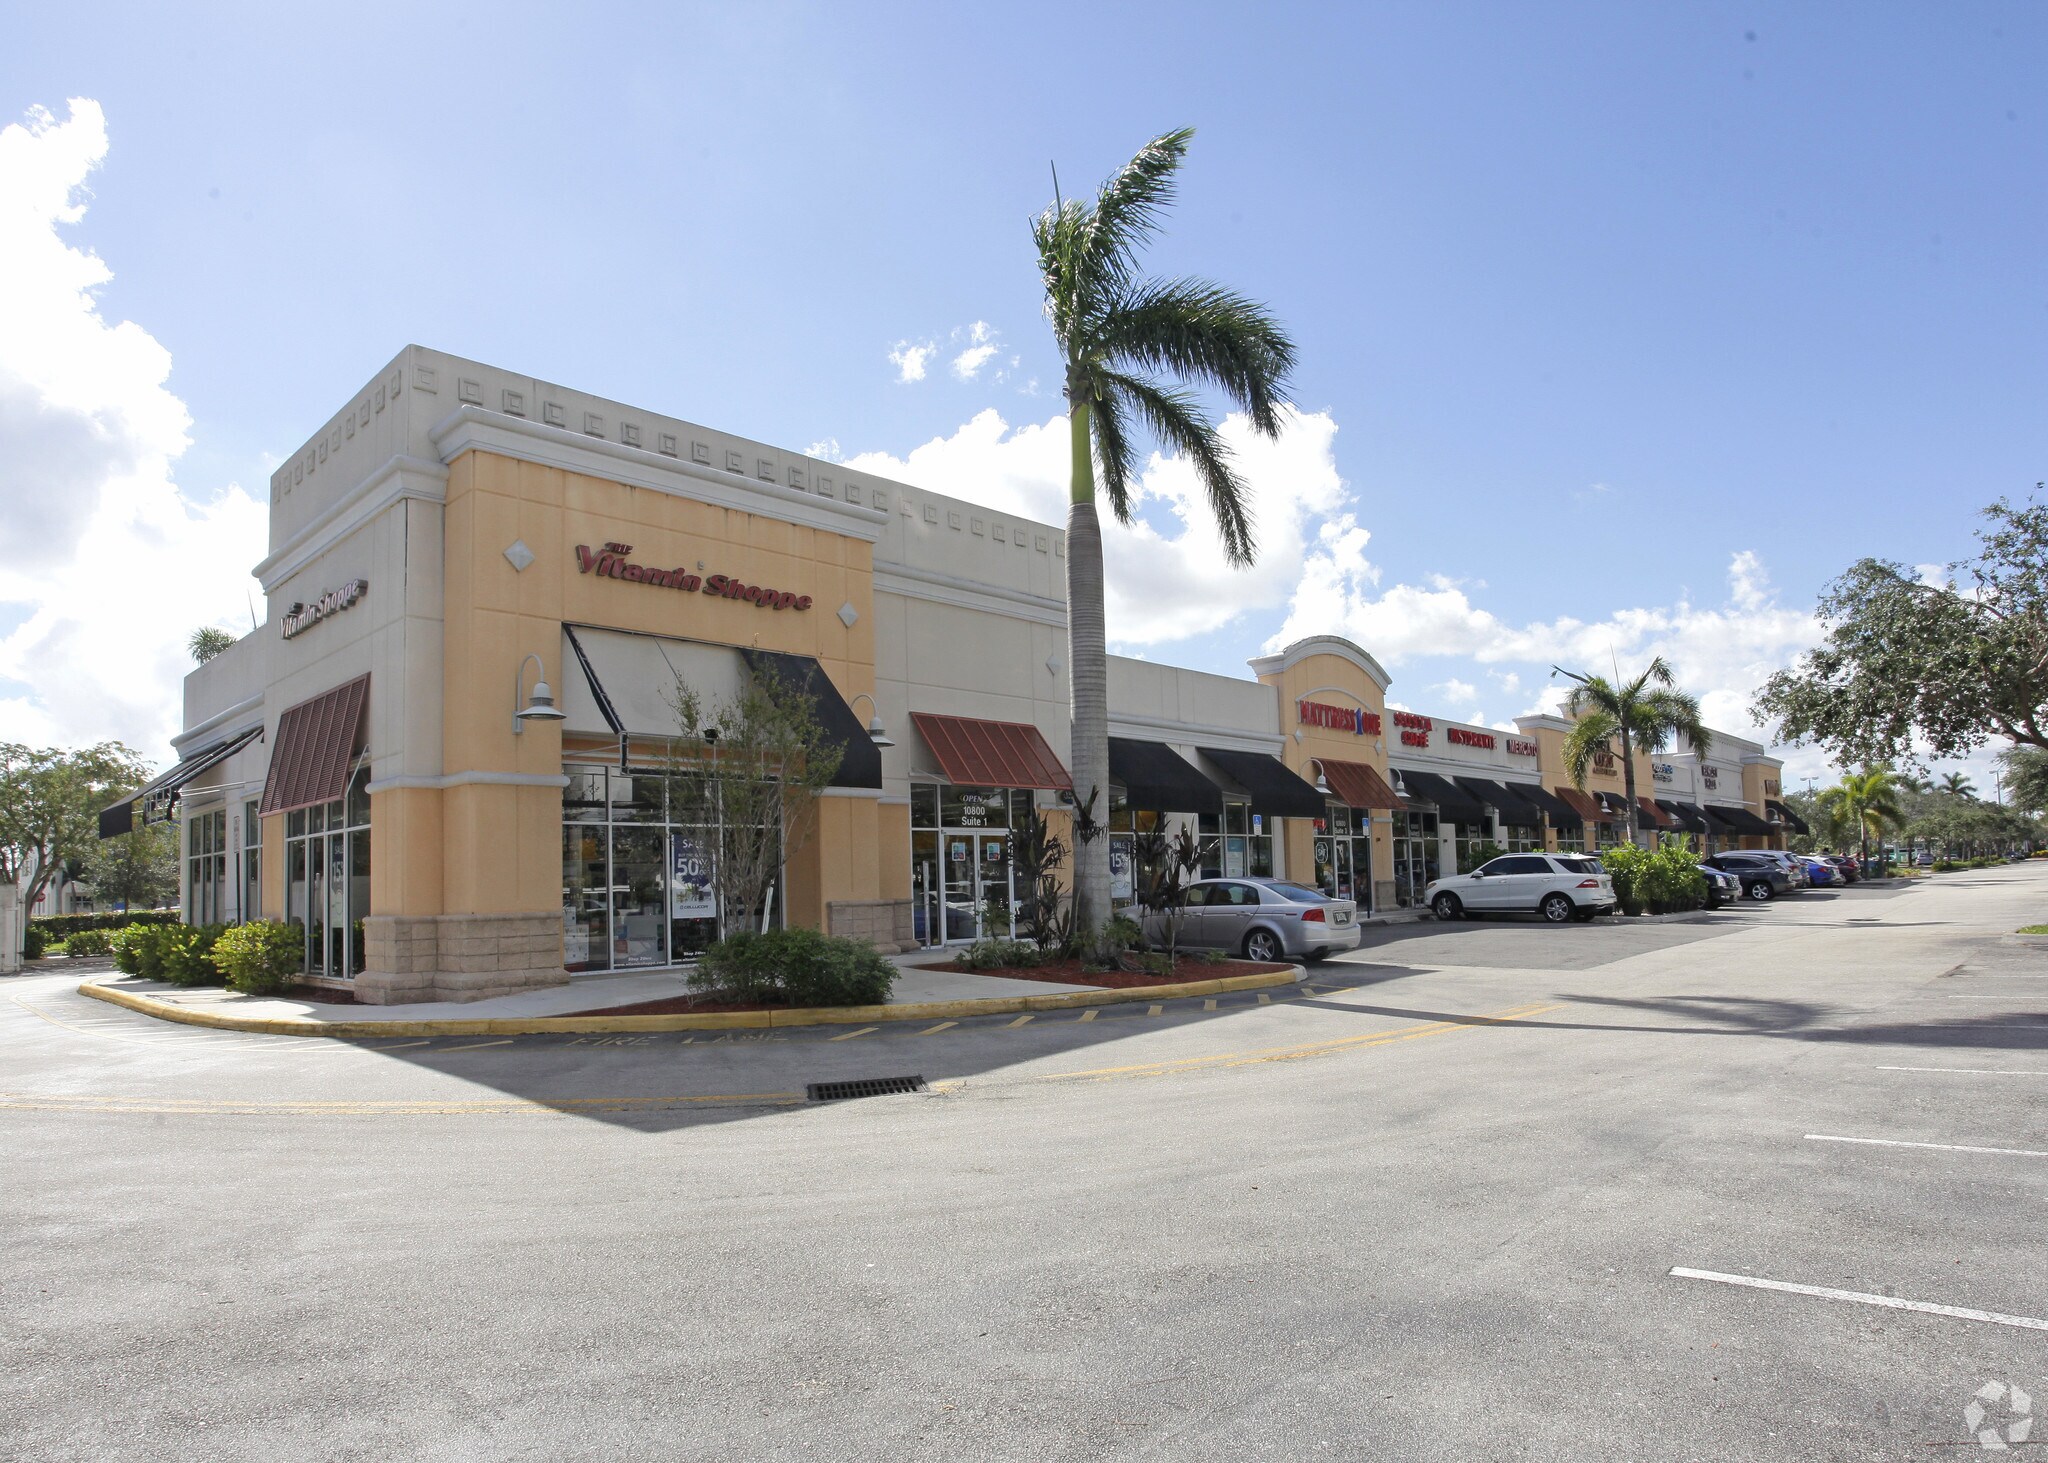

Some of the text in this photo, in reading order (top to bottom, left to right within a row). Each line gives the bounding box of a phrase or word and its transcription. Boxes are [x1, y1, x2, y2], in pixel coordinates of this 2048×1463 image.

[605, 542, 634, 555] THE
[576, 544, 813, 611] Vitamin Shoppe
[280, 579, 367, 640] Vitamin Shoppe
[1300, 700, 1356, 732] MATTRESS
[1362, 711, 1381, 736] ONE
[1447, 727, 1497, 750] RISTORANTE
[962, 794, 983, 803] OPEN
[963, 806, 985, 816] 10800
[961, 816, 988, 826] Suite 1
[566, 1036, 659, 1046] FIRE
